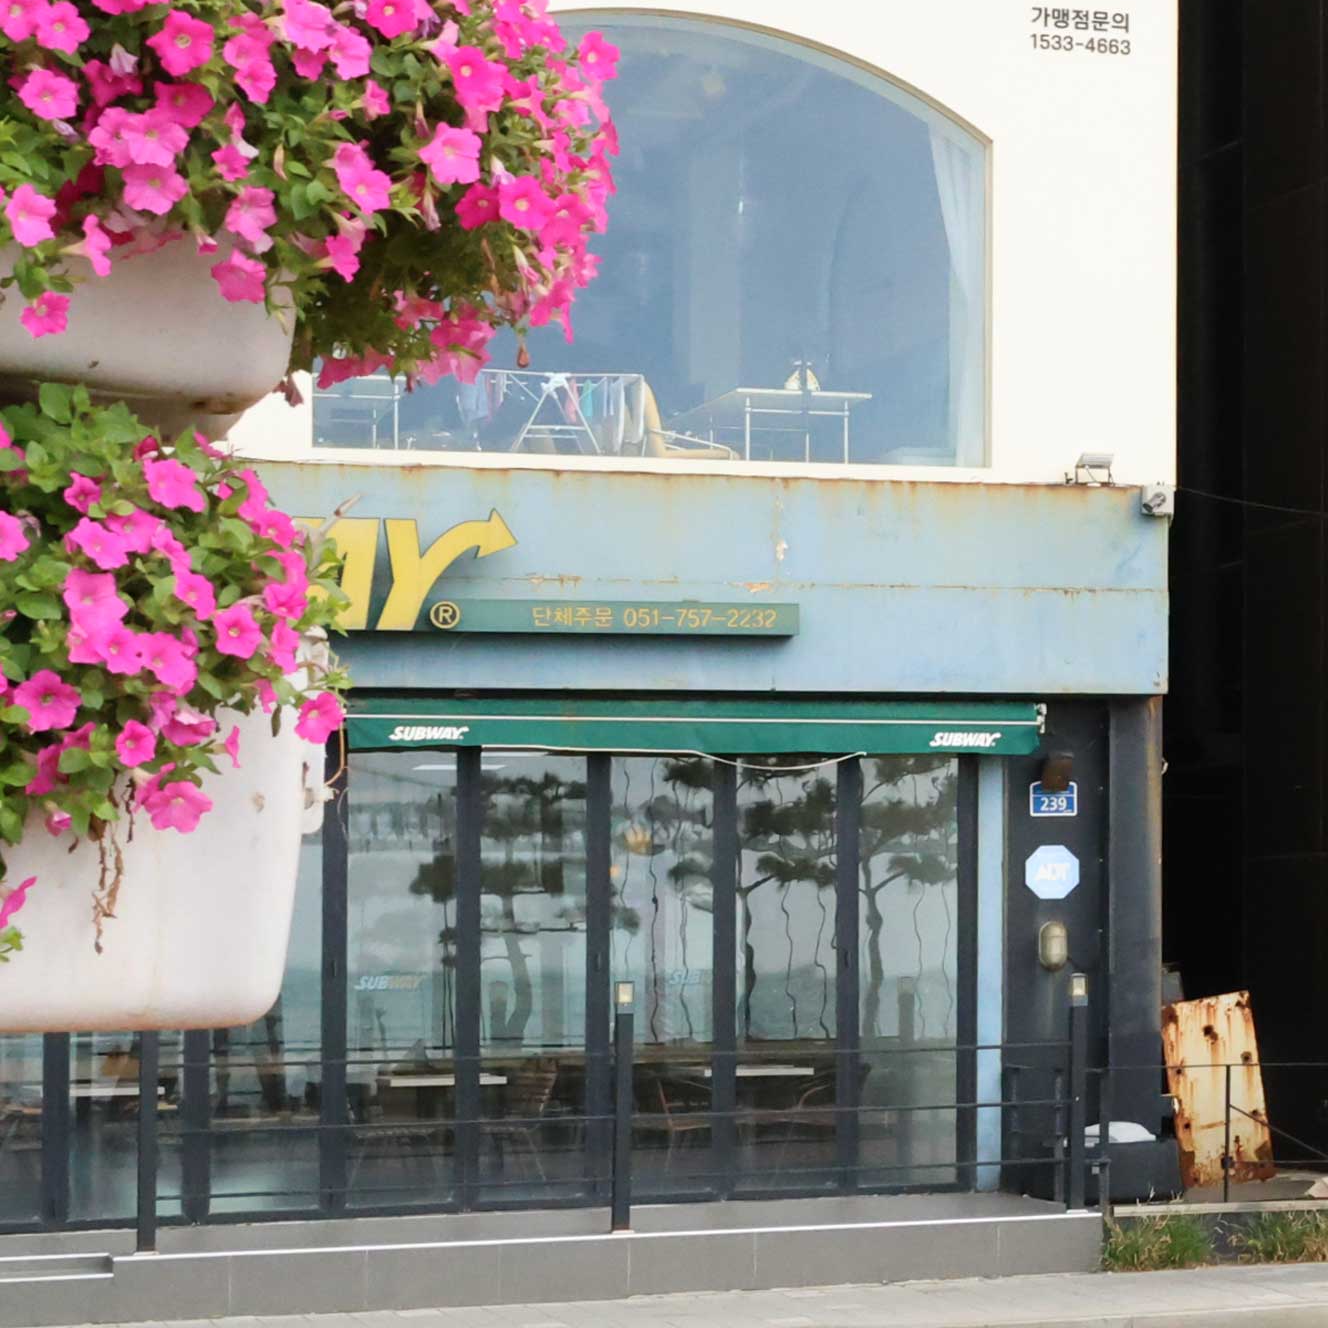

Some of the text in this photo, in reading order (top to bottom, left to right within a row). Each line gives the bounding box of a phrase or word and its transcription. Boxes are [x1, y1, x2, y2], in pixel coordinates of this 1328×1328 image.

[1031, 6, 1130, 33] 가맹점문의
[1029, 33, 1132, 56] 1533-4663
[532, 607, 778, 629] 단체주문 051-757-2232
[388, 725, 470, 741] SUBWAY
[929, 731, 1002, 747] SUBWAY
[1040, 796, 1067, 812] 239
